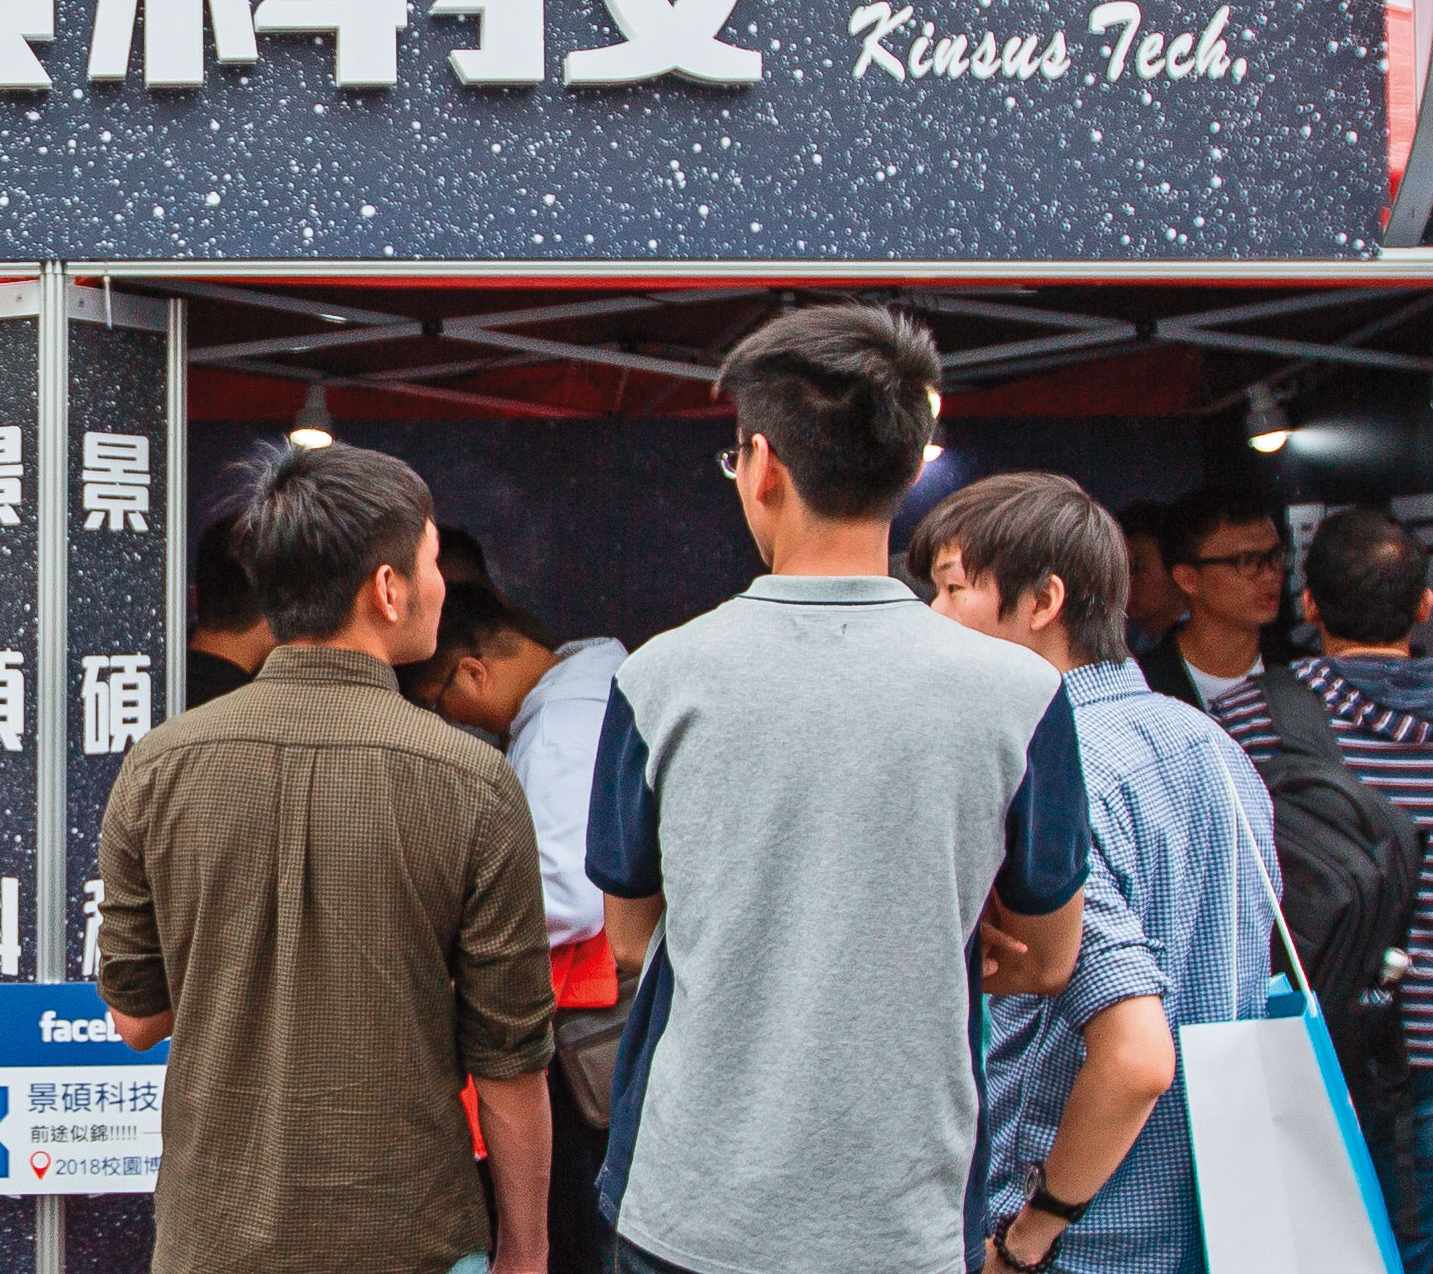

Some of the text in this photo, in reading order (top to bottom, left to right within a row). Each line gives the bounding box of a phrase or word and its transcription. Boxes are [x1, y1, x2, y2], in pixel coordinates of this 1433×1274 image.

[847, 0, 1249, 83] Kinsus Tech.
[27, 1080, 159, 1113] 景碩科技
